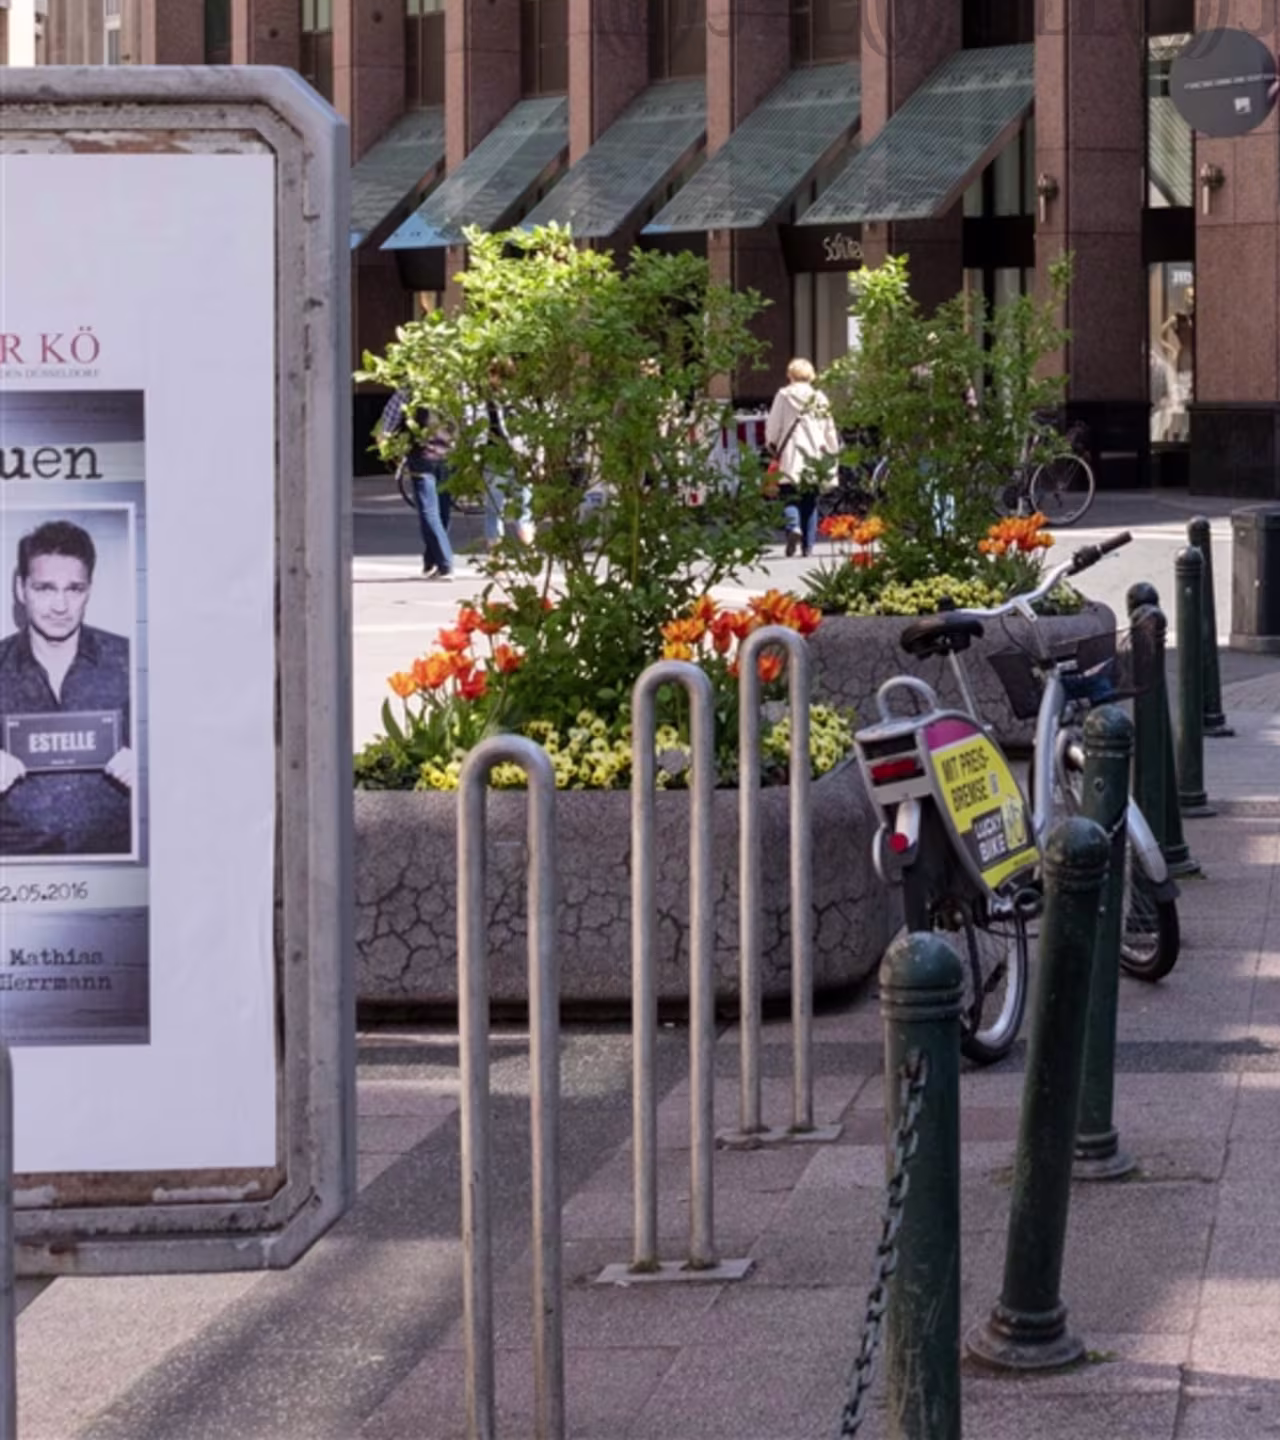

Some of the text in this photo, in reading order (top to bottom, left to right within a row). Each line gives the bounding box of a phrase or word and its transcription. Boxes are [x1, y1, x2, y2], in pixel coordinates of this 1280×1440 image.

[40, 326, 100, 364] KÖ
[29, 730, 97, 753] ESTELLE
[978, 833, 1007, 862] BIKE
[9, 947, 104, 966] Mathias
[0, 973, 113, 991] Herrmann
